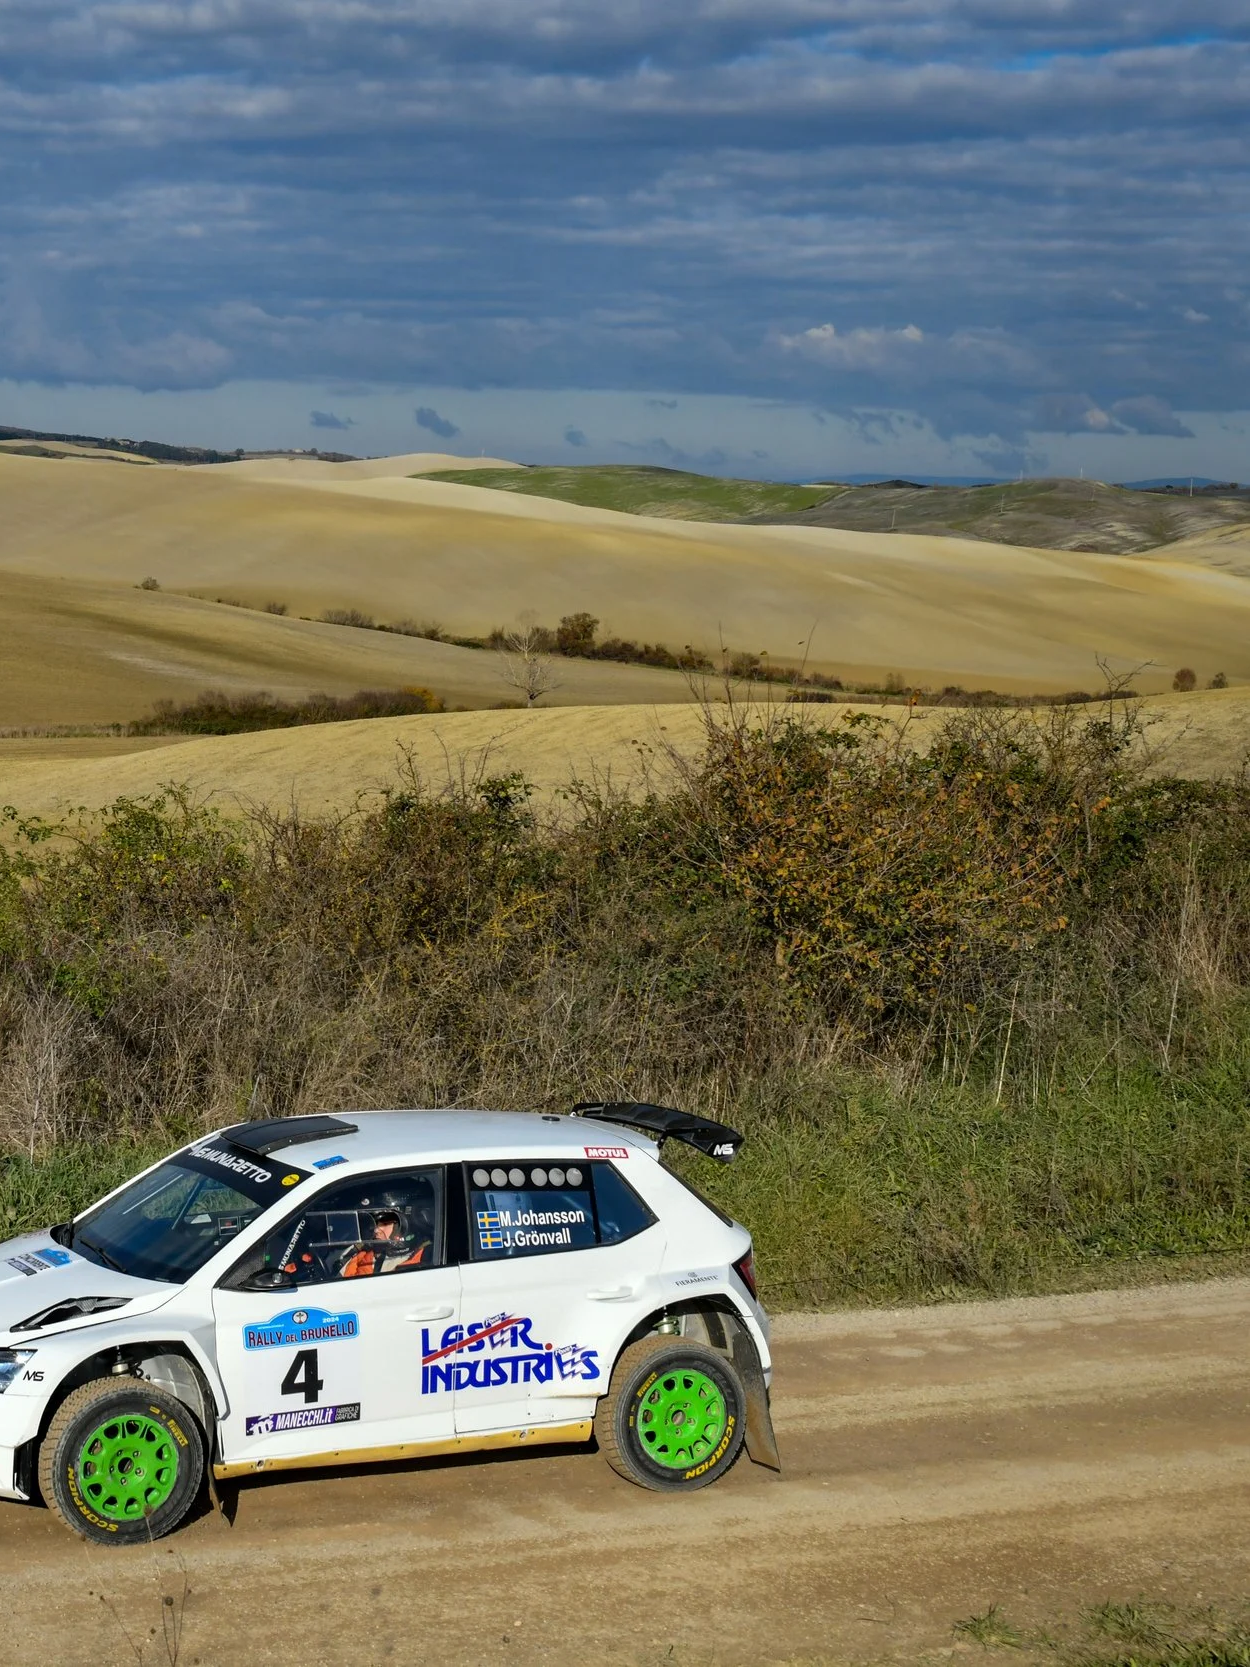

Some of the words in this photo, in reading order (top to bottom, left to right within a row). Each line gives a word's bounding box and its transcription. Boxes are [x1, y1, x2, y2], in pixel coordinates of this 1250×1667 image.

[588, 1149, 627, 1158] MOTUL
[713, 1143, 734, 1156] MS
[499, 1210, 585, 1227] M.Johansson
[503, 1228, 571, 1248] J.Grönvall
[322, 1316, 339, 1324] 2024
[248, 1331, 283, 1347] RALLY
[285, 1334, 298, 1343] DEL
[301, 1321, 355, 1341] BRUNELLO
[421, 1317, 544, 1359] LASER
[23, 1370, 45, 1381] MS
[281, 1348, 324, 1404] 4
[421, 1350, 600, 1395] INDUSTRIES
[275, 1408, 334, 1430] MANECCHI.it
[167, 1419, 189, 1447] PIRELLI
[685, 1415, 735, 1479] SCORPION
[67, 1466, 119, 1532] SCORPION
